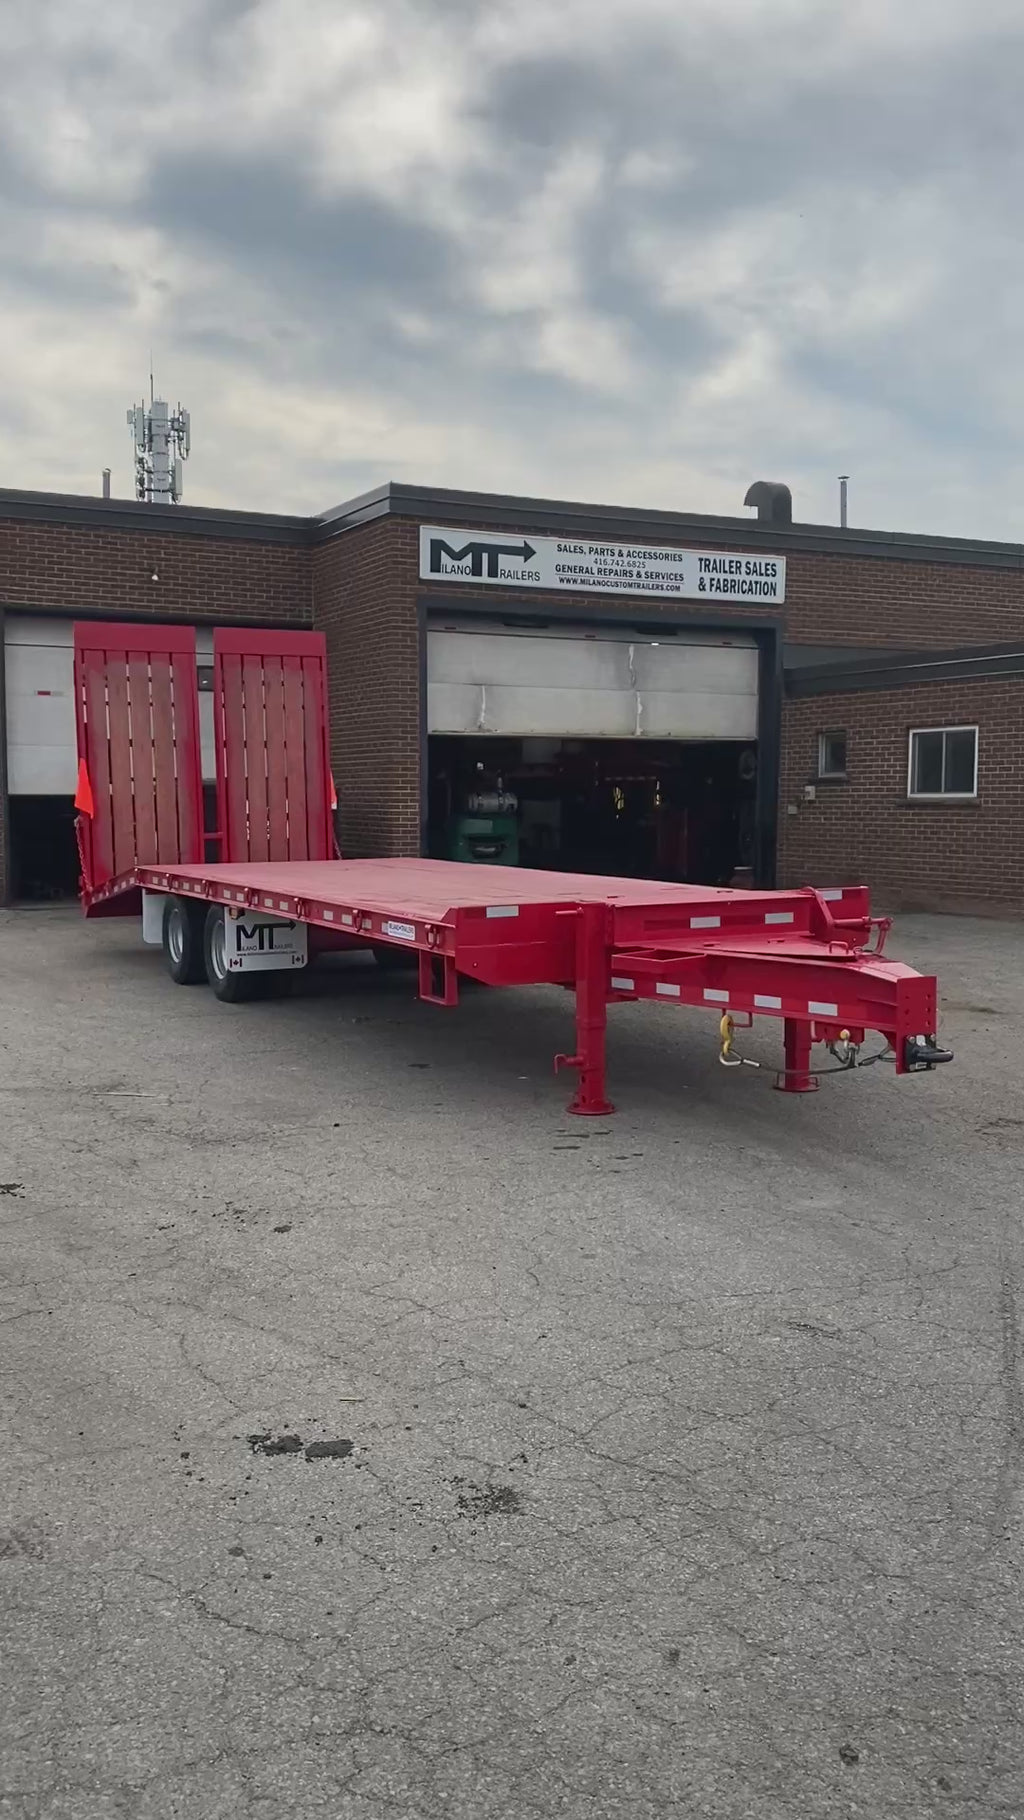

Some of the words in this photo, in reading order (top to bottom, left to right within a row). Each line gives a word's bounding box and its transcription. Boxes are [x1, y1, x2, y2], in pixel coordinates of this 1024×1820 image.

[557, 544, 586, 555] SALES,
[588, 546, 615, 557] PARTS
[617, 549, 624, 558] &
[626, 550, 683, 562] ACCESSORIES
[593, 558, 647, 569] 416.742.6825
[698, 557, 742, 575] TRAILER
[745, 561, 777, 578] SALES
[555, 564, 595, 575] GENERAL
[597, 567, 634, 578] REPAIRS
[636, 570, 642, 579] &
[644, 571, 684, 581] SERVICES
[558, 576, 681, 592] WWW.MILANOCUSTOMTRAILERS.COM
[698, 577, 706, 592] &
[709, 577, 777, 596] FABRICATION
